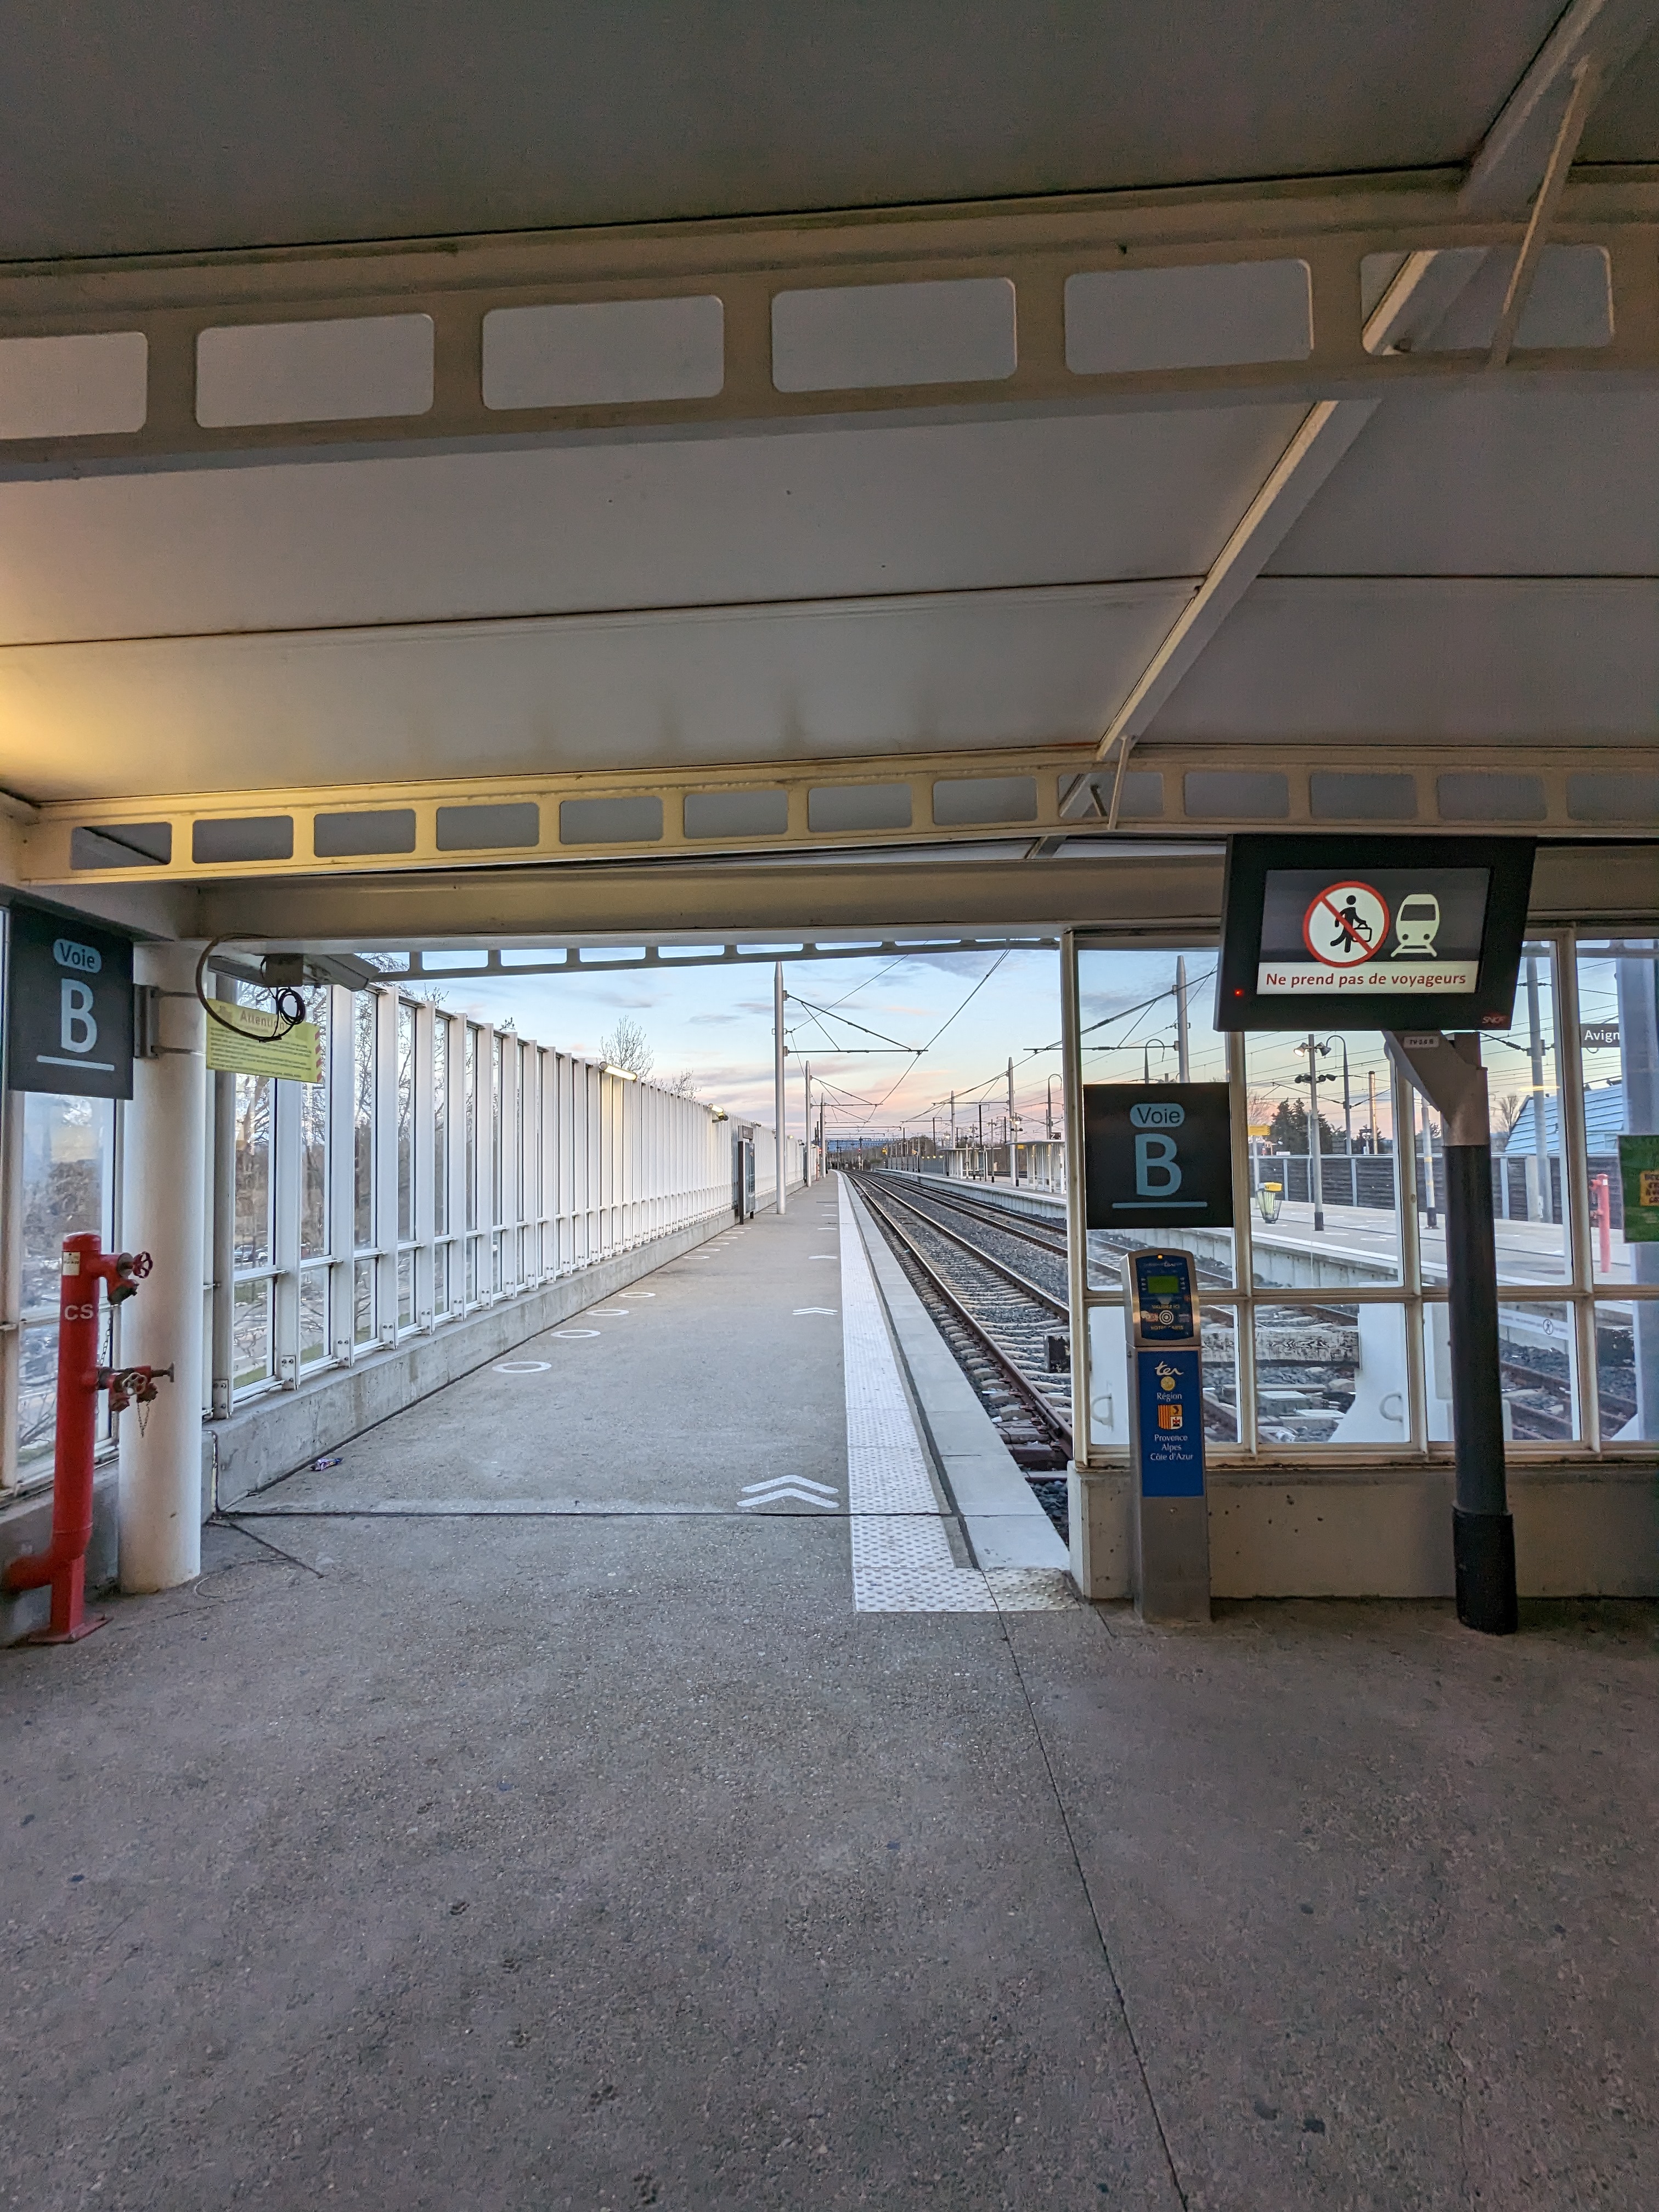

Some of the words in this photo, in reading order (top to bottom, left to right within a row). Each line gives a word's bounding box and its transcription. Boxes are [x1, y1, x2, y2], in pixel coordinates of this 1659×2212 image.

[60, 943, 95, 969] Voie
[1266, 973, 1286, 985] Ne
[1291, 973, 1334, 988] prend
[1339, 975, 1364, 987] pas
[1369, 973, 1386, 984] de
[1392, 973, 1466, 987] voyageurs
[61, 978, 97, 1053] B
[1137, 1107, 1180, 1124] Voie
[1135, 1133, 1182, 1197] B
[65, 1304, 94, 1321] CS
[1154, 1361, 1184, 1376] ter
[1156, 1392, 1183, 1402] Région
[1161, 1443, 1182, 1453] Alpes
